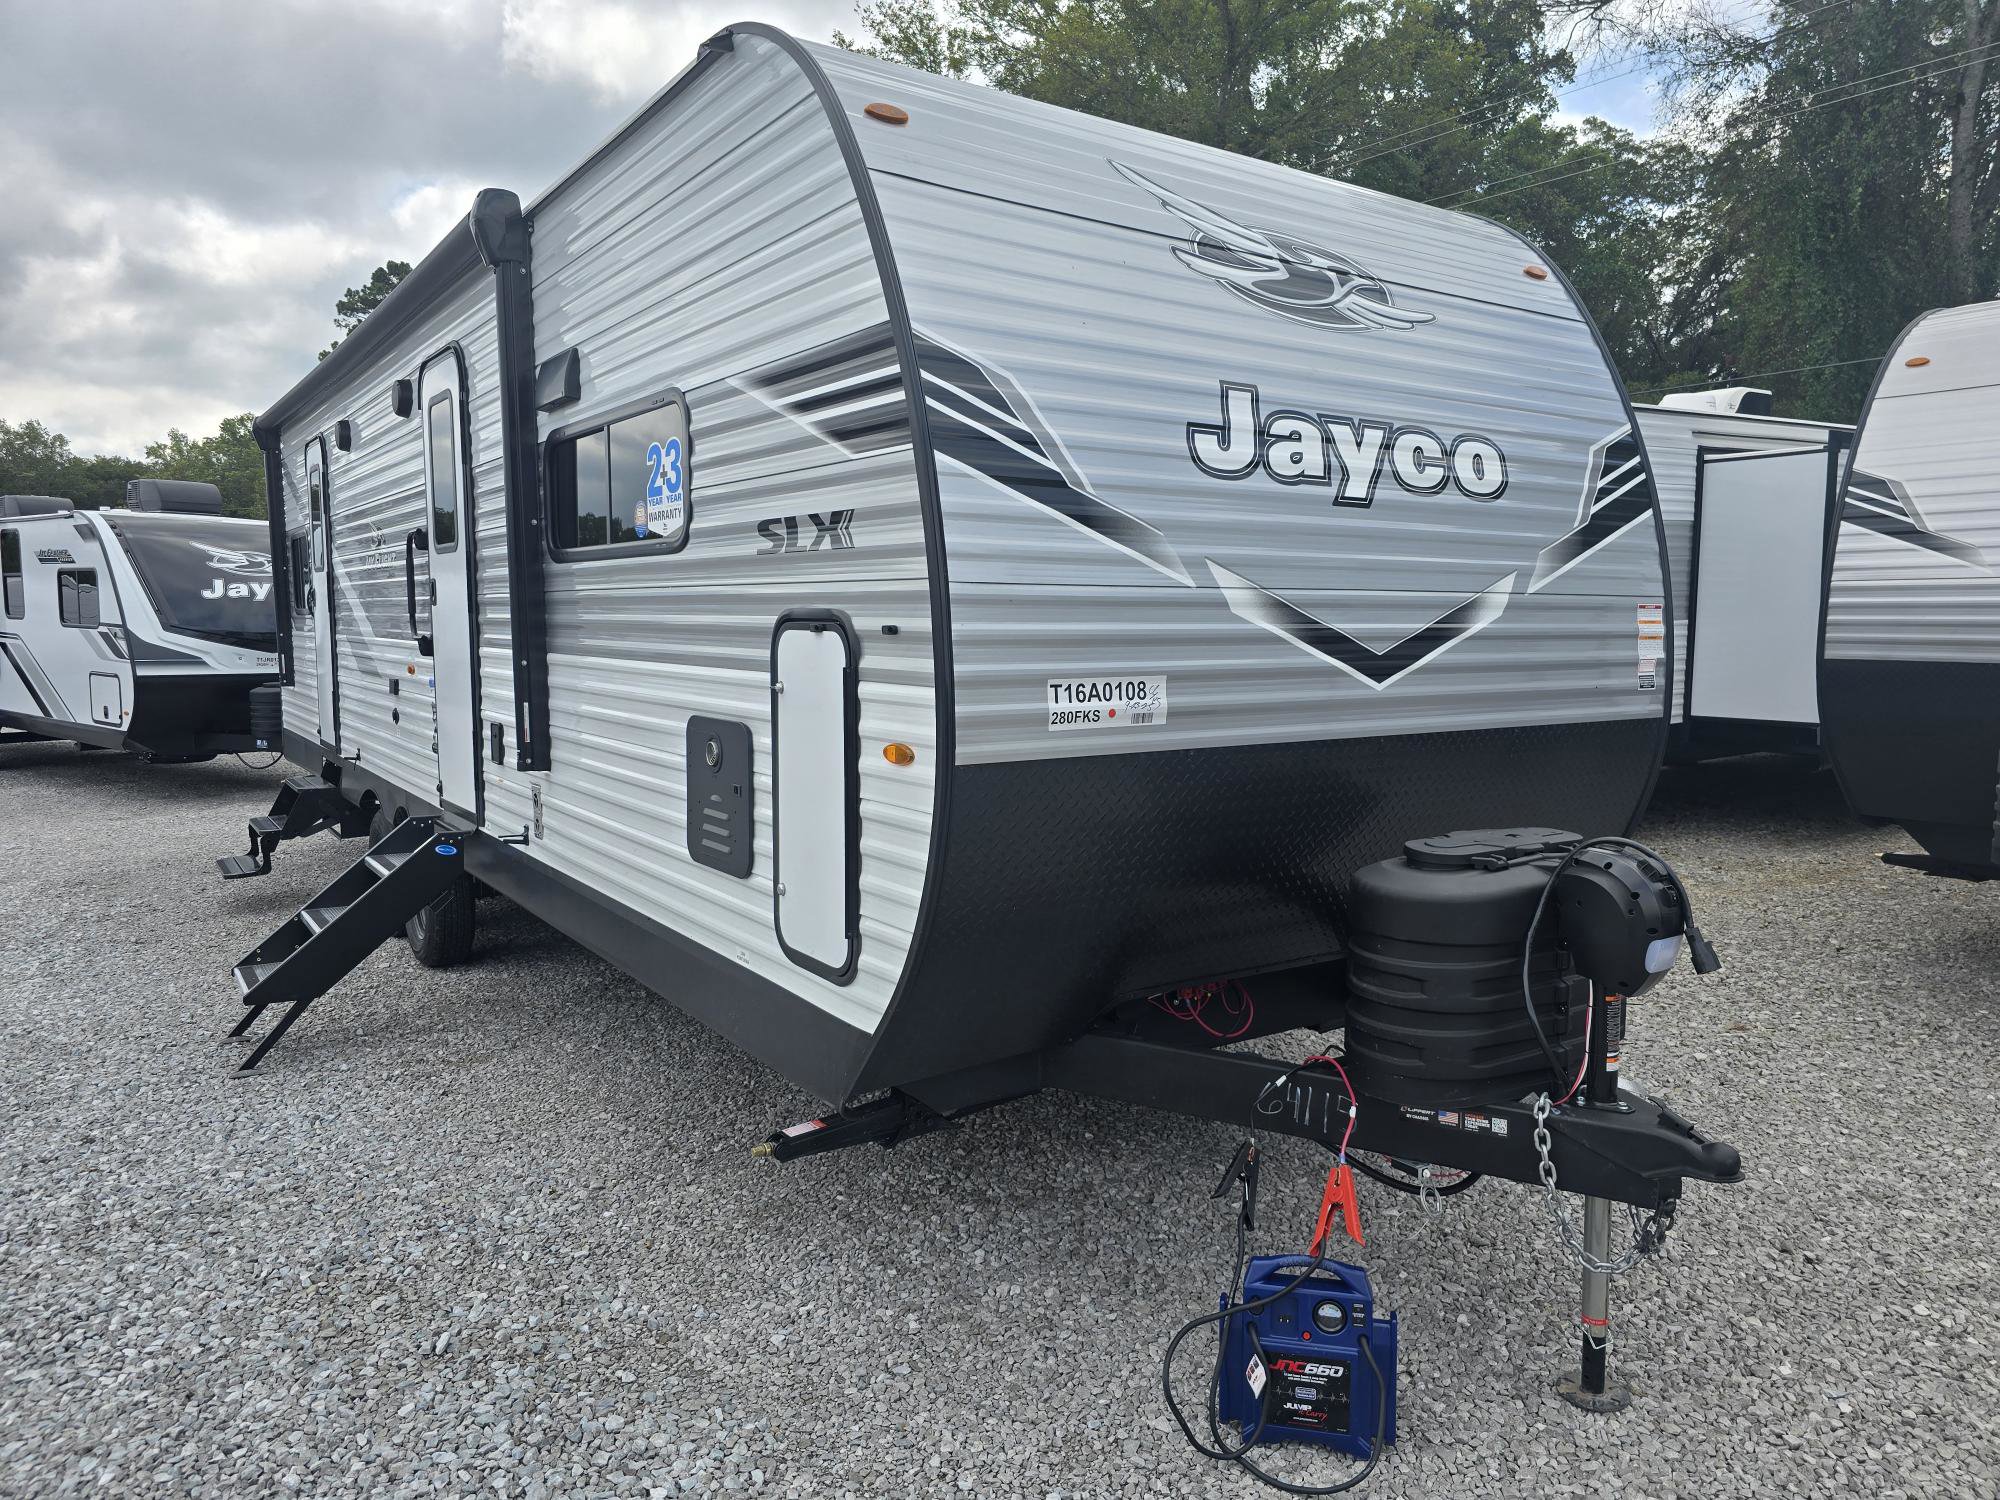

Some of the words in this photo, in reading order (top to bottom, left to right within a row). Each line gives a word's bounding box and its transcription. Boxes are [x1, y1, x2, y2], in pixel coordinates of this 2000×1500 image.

[1186, 379, 1509, 508] Jayco
[648, 496, 663, 507] YEAR
[666, 493, 682, 504] YEAR
[648, 507, 682, 523] WARRANTY
[757, 509, 855, 555] SLX
[1049, 680, 1147, 704] T16A0108
[1050, 709, 1101, 725] 280FKS
[1269, 1359, 1344, 1378] JNC660
